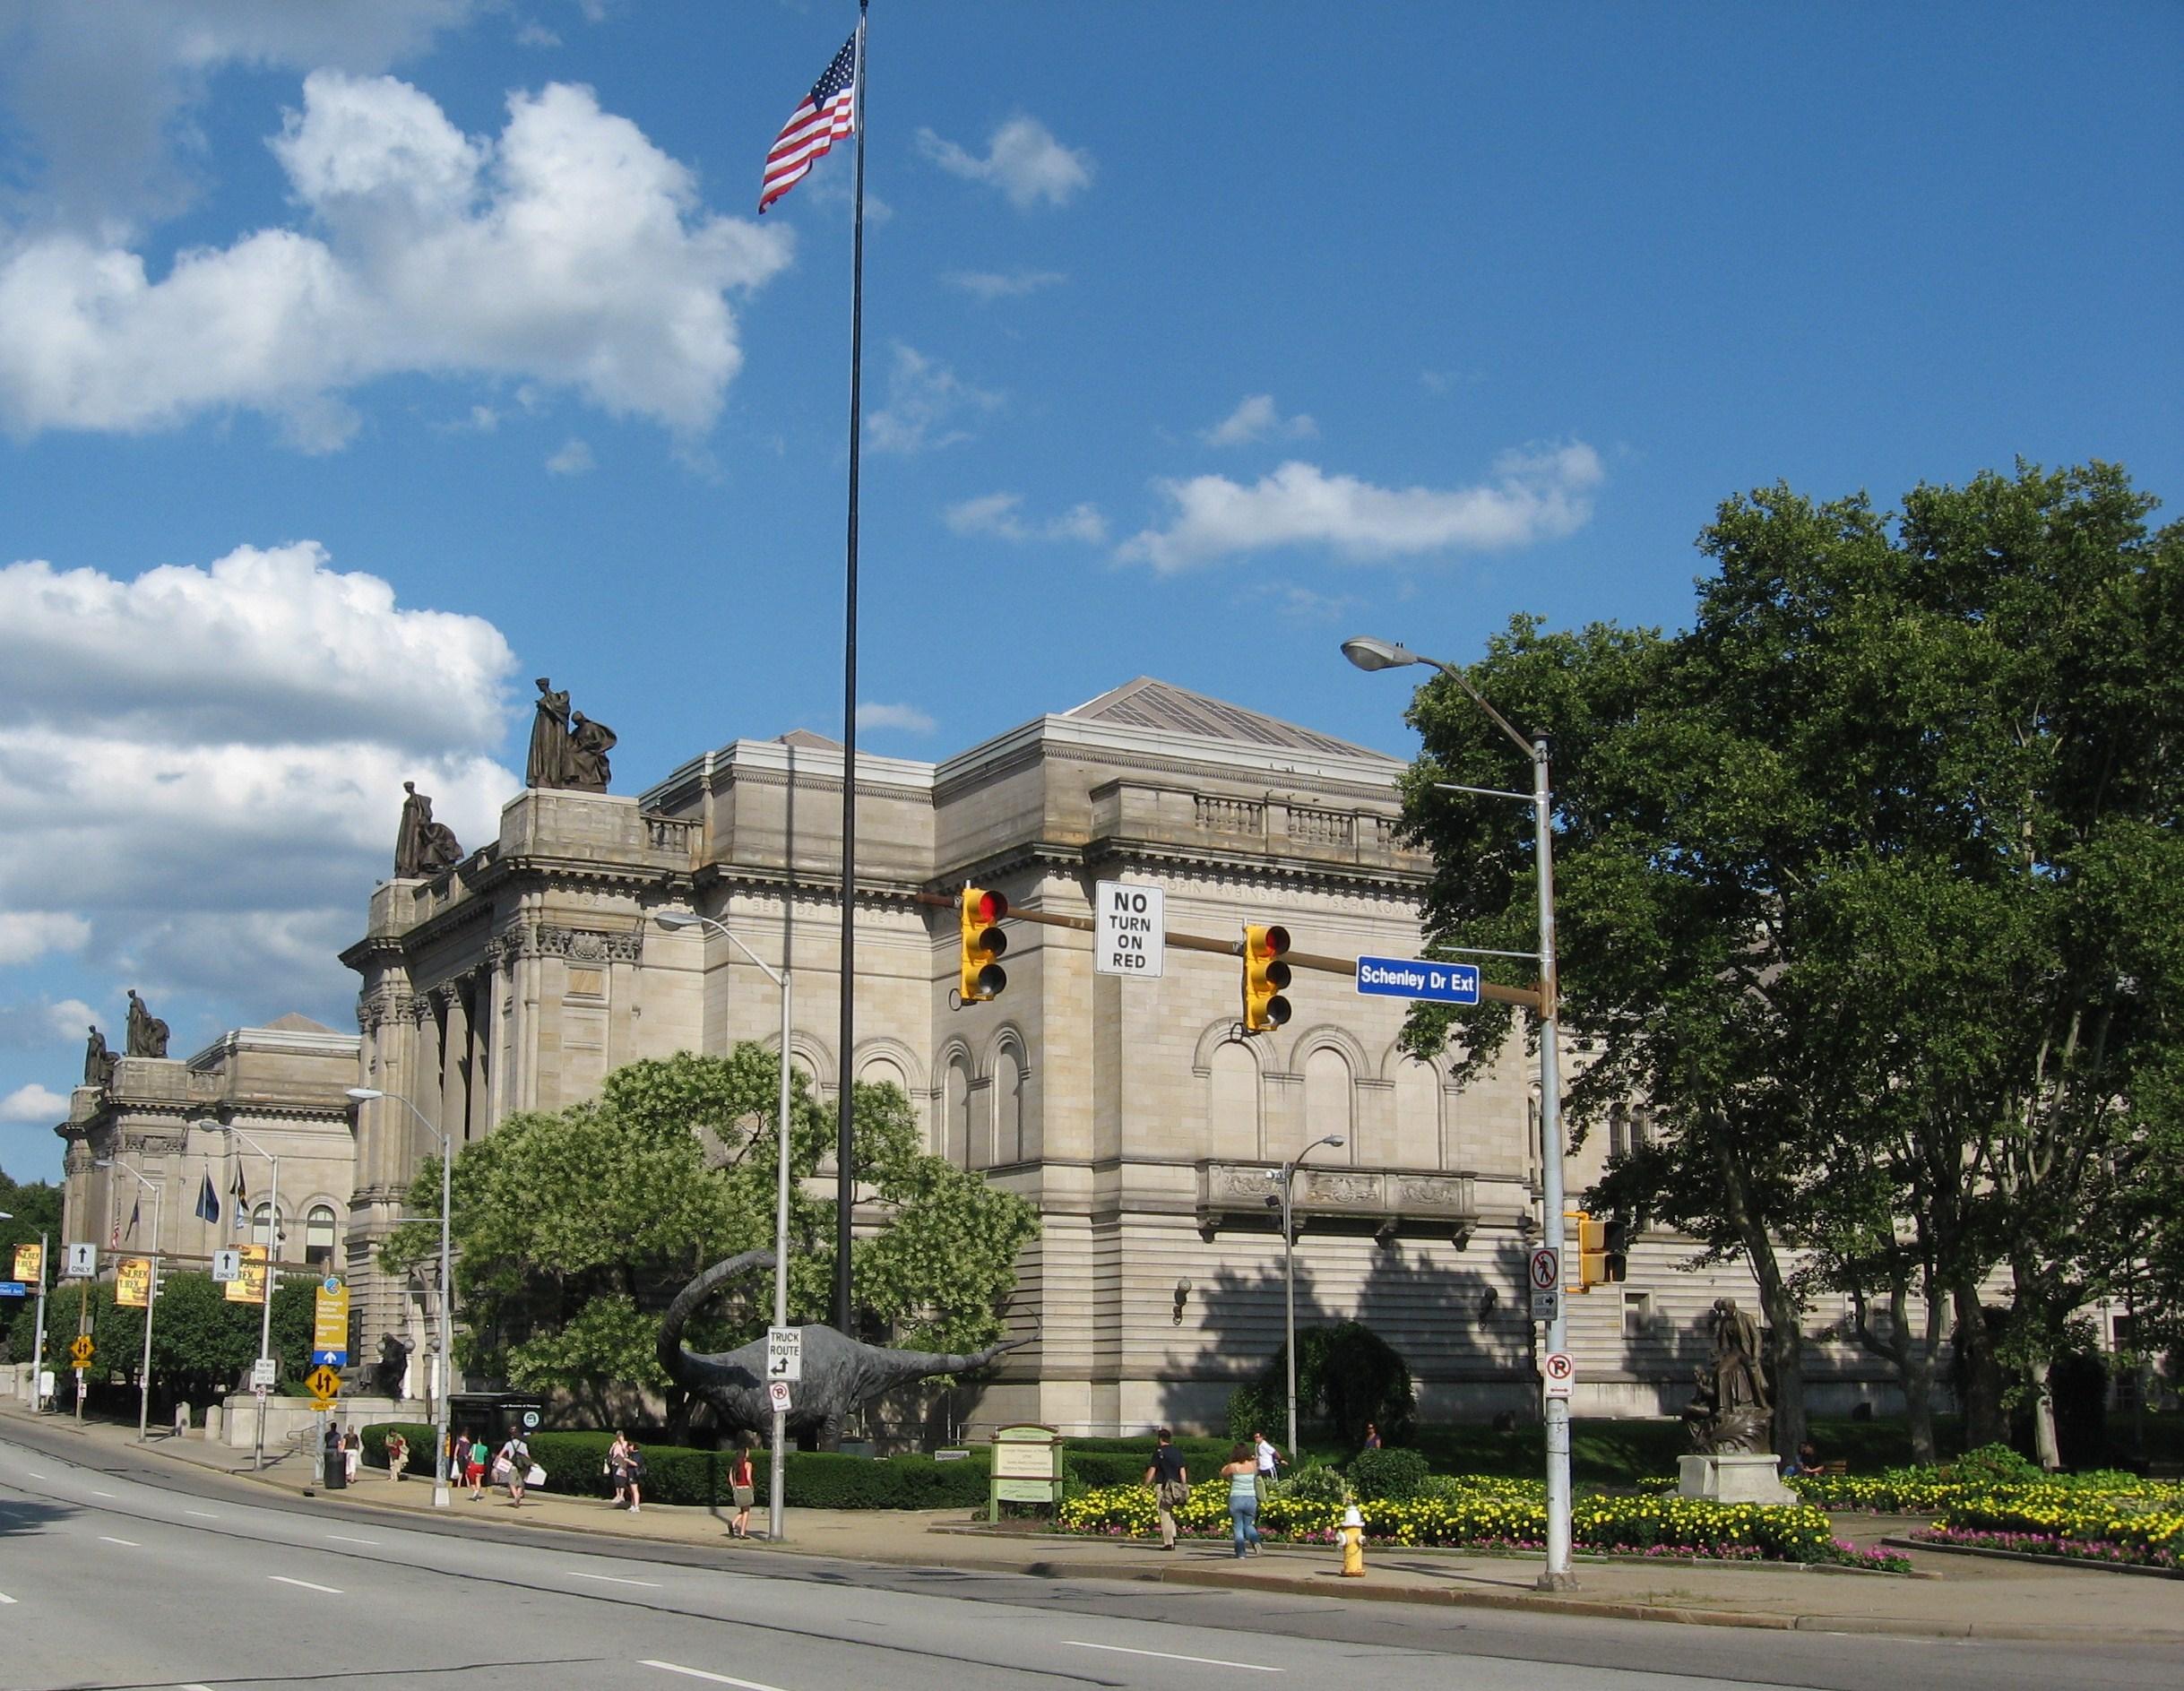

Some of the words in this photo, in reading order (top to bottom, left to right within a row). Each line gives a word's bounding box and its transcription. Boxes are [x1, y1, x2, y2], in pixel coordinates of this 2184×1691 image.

[1115, 892, 1147, 913] NO
[1109, 915, 1151, 932] TURN
[1118, 934, 1142, 950] ON
[1113, 953, 1145, 969] RED
[1361, 965, 1425, 990] Schenley
[1430, 971, 1446, 989] Dr
[1452, 974, 1474, 991] Ext
[72, 1265, 91, 1273] ONLY
[771, 1332, 799, 1342] TRUCK
[770, 1345, 799, 1356] ROUTE
